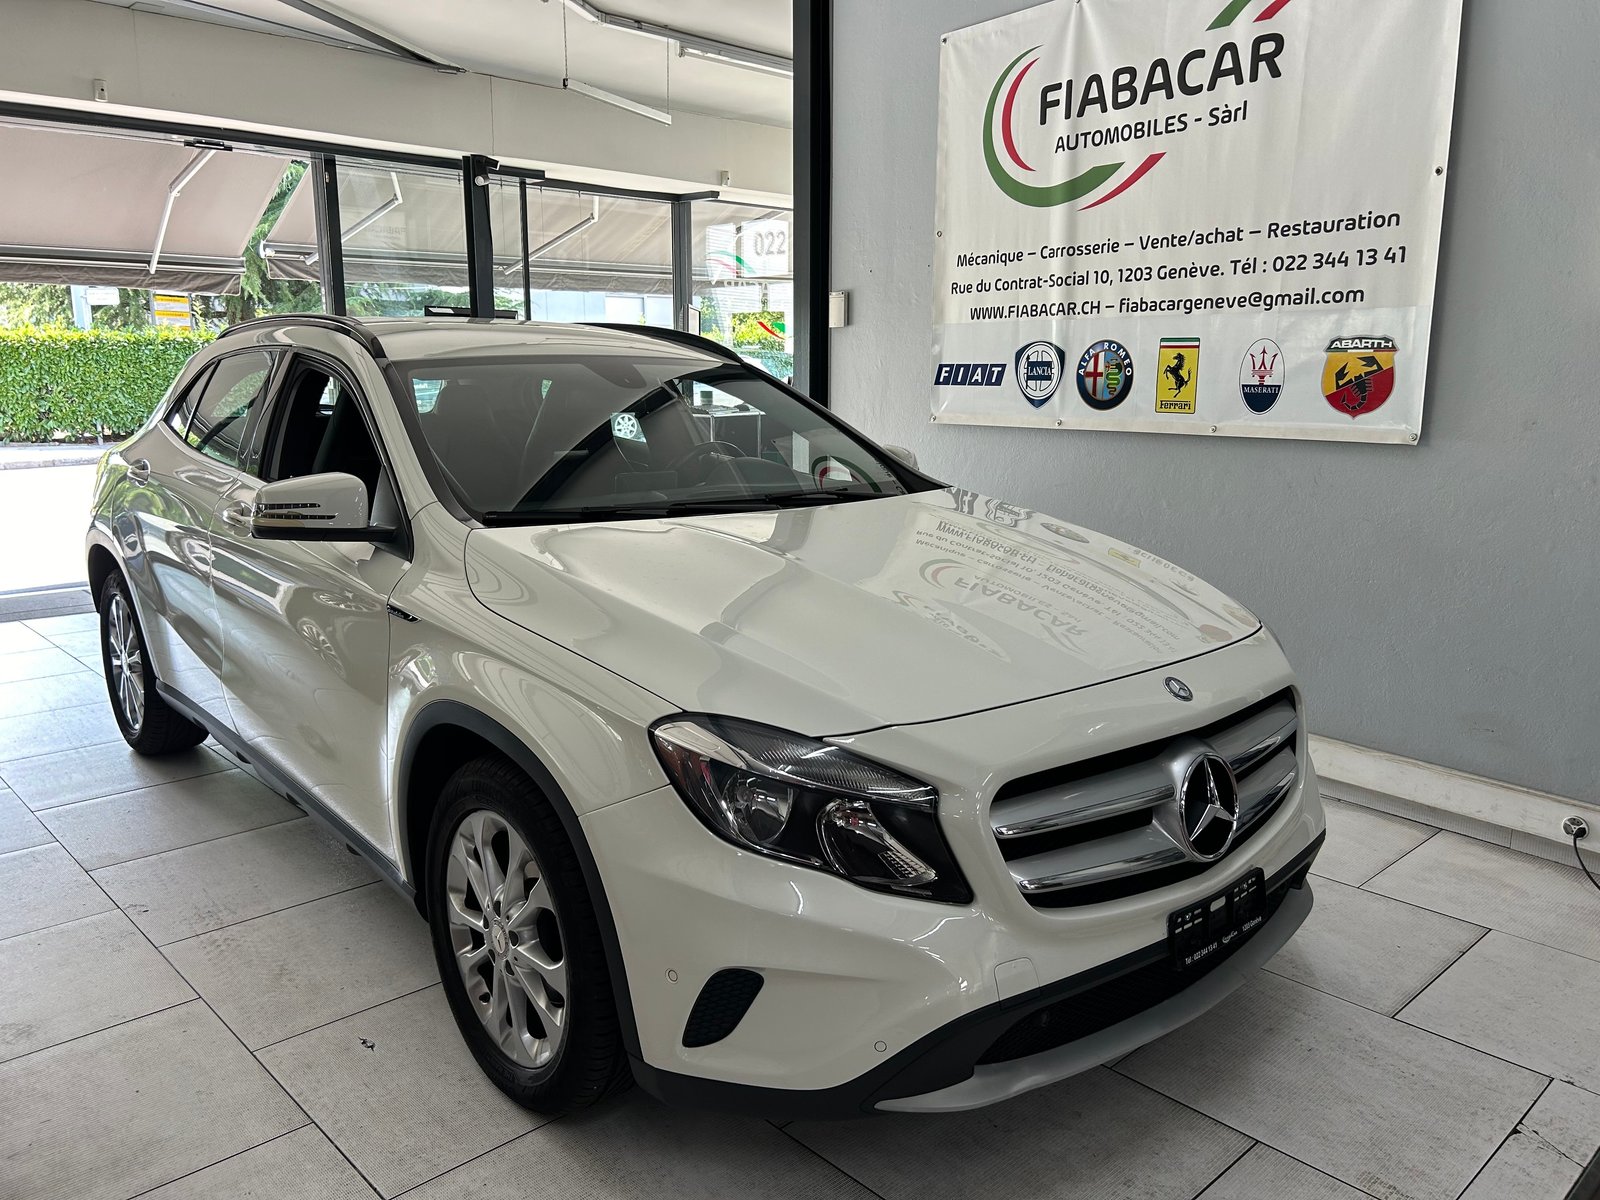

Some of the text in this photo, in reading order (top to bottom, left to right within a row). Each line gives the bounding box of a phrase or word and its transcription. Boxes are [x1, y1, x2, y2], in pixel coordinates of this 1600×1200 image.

[1039, 32, 1285, 126] FIABACAR
[1054, 113, 1188, 154] AUTOMOBILES
[1208, 100, 1247, 126] Sàrl
[957, 250, 1023, 267] Mécanique
[1041, 238, 1119, 259] Carrosserie
[1140, 228, 1243, 250] Vente/achat
[1268, 211, 1400, 238] Restauration
[952, 283, 972, 294] Rue
[976, 279, 991, 292] du
[995, 271, 1089, 291] Contrat-Social
[1094, 270, 1112, 286] 10,
[1118, 267, 1152, 282] 1203
[1157, 262, 1224, 280] Genève.
[1230, 257, 1256, 275] Tél
[1273, 255, 1307, 272] 022
[1313, 251, 1348, 269] 344
[1357, 249, 1377, 266] 13
[1384, 246, 1406, 263] 41
[971, 301, 1100, 320] WWW.FIABACAR.CH
[1120, 288, 1364, 314] fiabacargeneve@gmail.com
[1079, 342, 1132, 376] ALFA ROMEO
[1331, 339, 1393, 349] ABARTH
[939, 367, 1002, 383] FIAT
[1028, 366, 1052, 376] LANCIA
[1160, 400, 1191, 410] Ferrari
[1243, 386, 1280, 394] MASERATI
